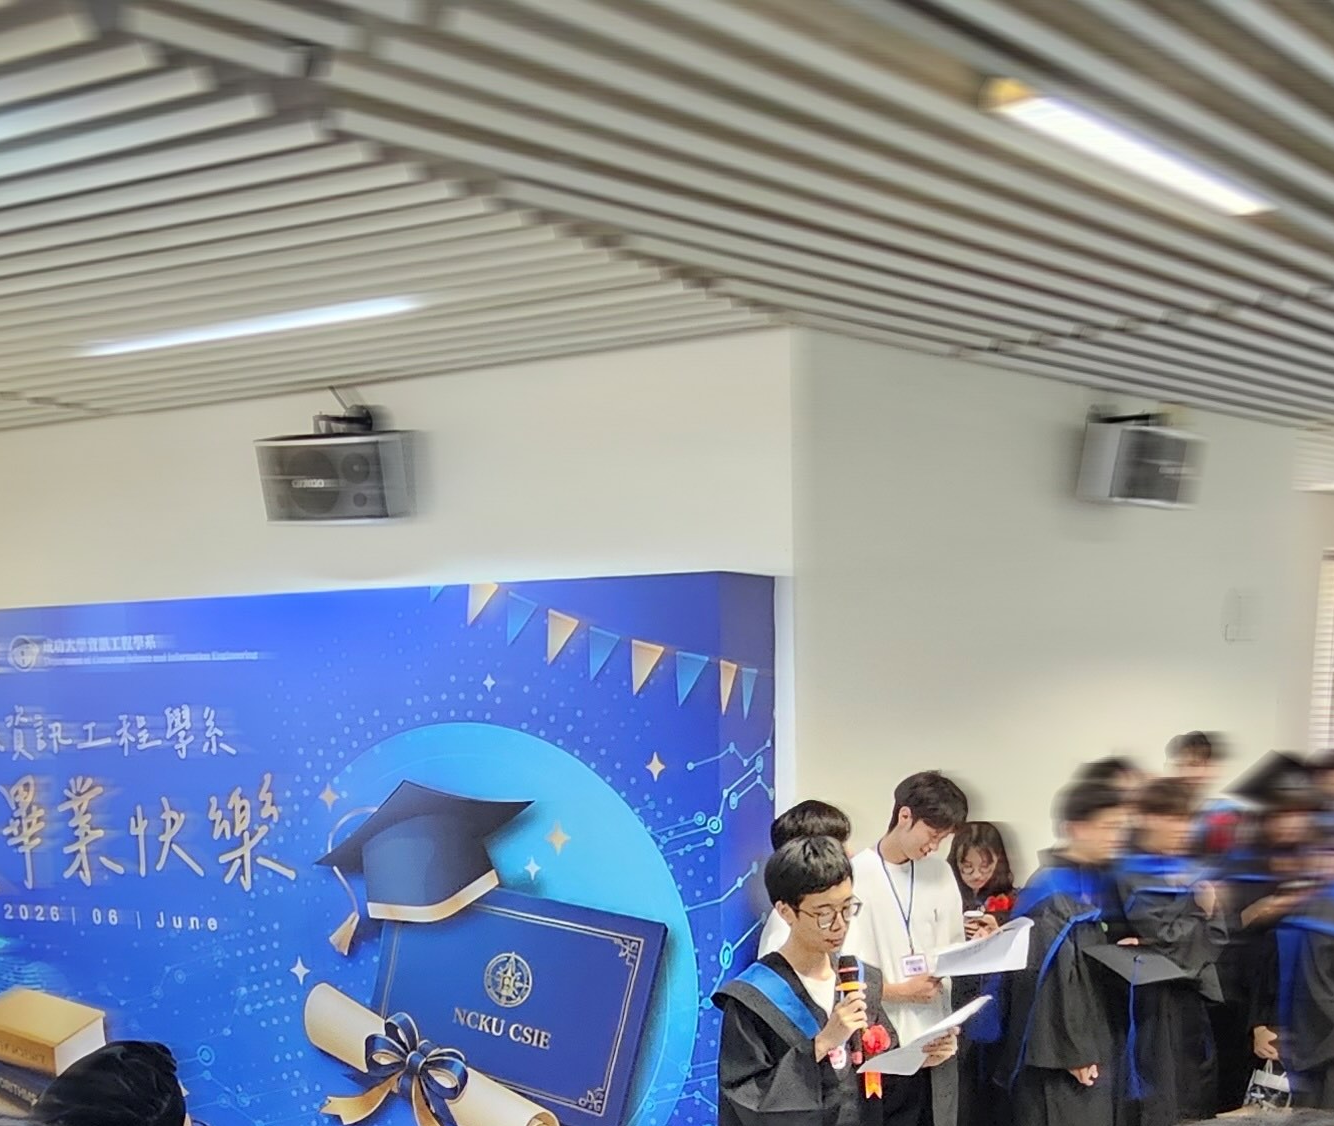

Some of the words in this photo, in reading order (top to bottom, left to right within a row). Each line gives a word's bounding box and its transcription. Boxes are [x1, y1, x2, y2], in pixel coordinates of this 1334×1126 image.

[0, 773, 297, 892] 畢業快樂
[3, 903, 60, 923] 2026
[92, 907, 119, 926] 06
[156, 911, 218, 932] June
[452, 1006, 506, 1037] NCKU
[508, 1023, 552, 1051] CSIE
